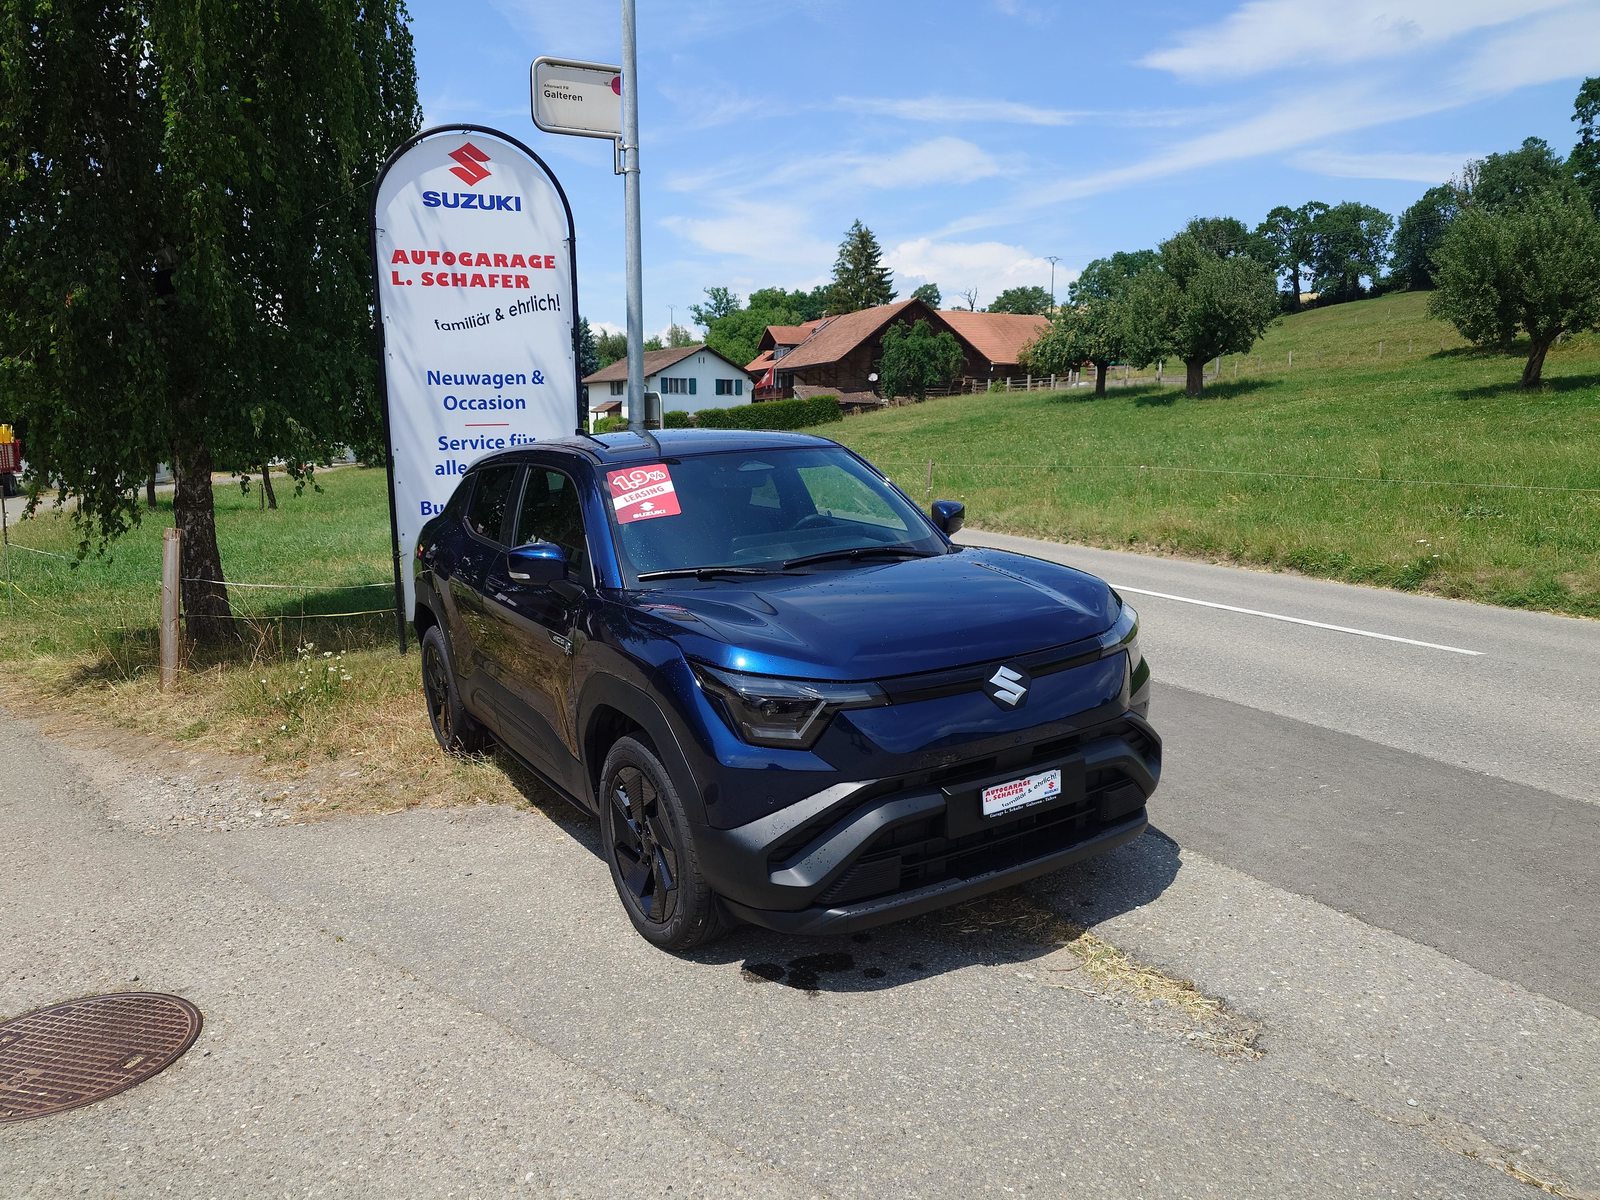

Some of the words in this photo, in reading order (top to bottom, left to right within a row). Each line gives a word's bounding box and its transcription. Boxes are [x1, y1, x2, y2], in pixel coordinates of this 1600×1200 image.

[543, 89, 583, 101] Galteren
[422, 190, 522, 212] SUZUKI
[391, 249, 556, 269] AUTOGARAGE
[391, 271, 413, 286] L.
[421, 272, 530, 289] SCHAFER
[434, 311, 491, 331] familiär
[495, 307, 505, 321] &
[508, 293, 561, 317] ehrlich!
[426, 370, 527, 390] Neuwagen
[531, 370, 545, 385] &
[443, 394, 527, 411] Occasion
[437, 434, 506, 451] Service
[623, 485, 665, 503] LEASING
[420, 501, 444, 516] Bu
[632, 509, 667, 519] SUZUKI
[985, 780, 1031, 797] AUTOGARAGE
[993, 788, 1024, 801] SCHAFER
[1001, 792, 1027, 808] familiär
[1034, 773, 1057, 789] ehrlich!
